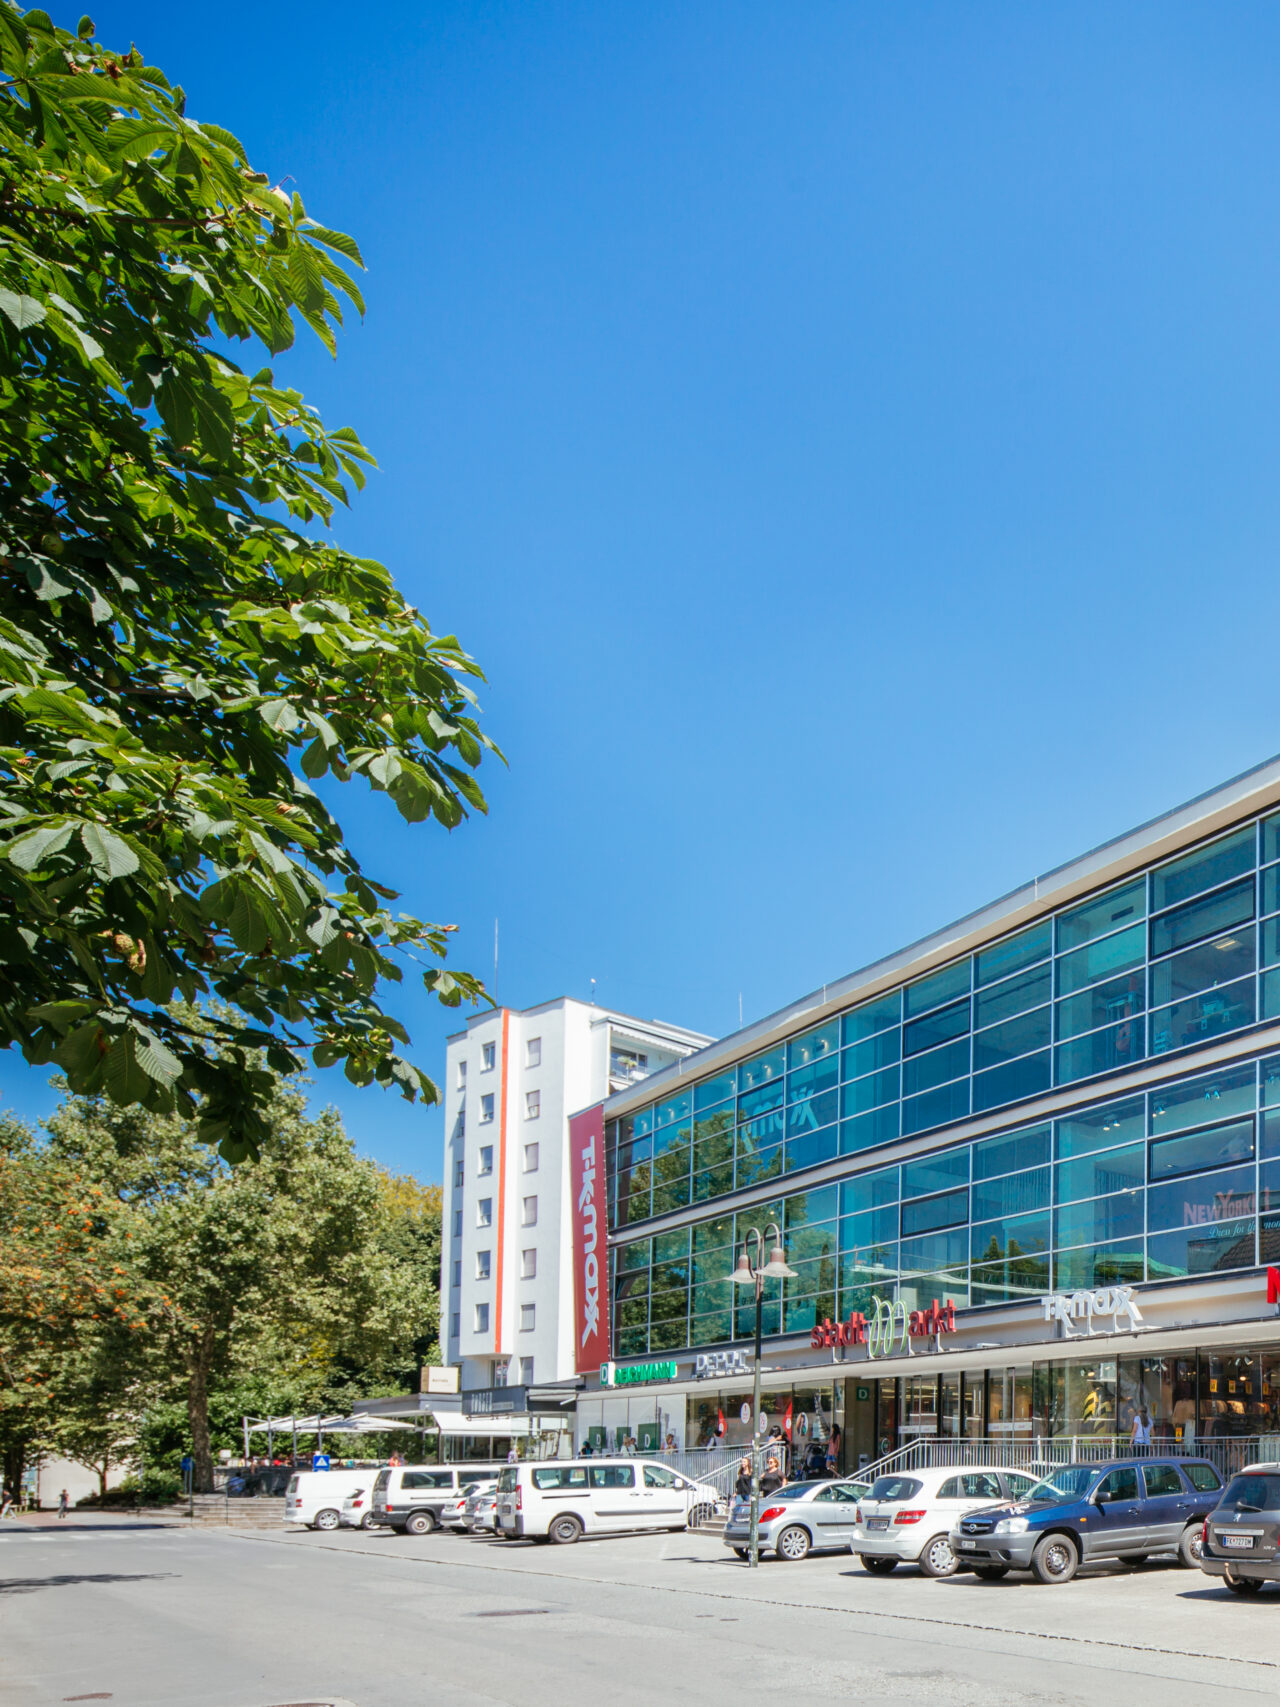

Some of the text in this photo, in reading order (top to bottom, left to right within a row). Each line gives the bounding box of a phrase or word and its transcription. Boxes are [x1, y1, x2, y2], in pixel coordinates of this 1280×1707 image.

[1232, 1224, 1244, 1238] for
[696, 1349, 749, 1371] DEPOT
[614, 1361, 678, 1385] DEICHMANN
